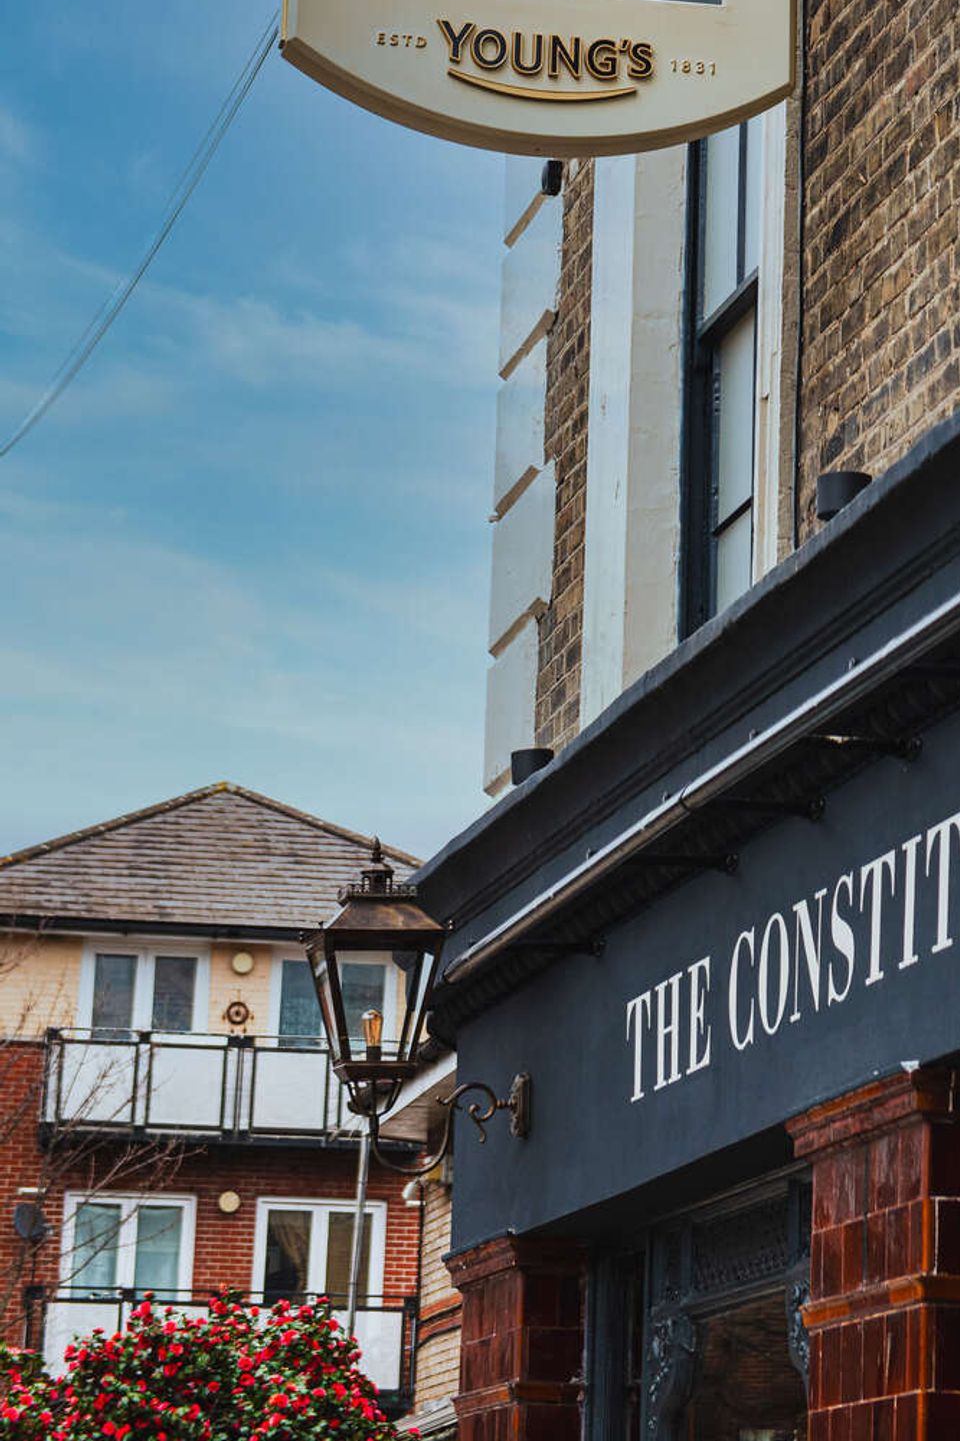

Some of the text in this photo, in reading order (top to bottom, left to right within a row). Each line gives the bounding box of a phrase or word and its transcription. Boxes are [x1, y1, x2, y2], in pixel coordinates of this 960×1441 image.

[375, 18, 717, 80] ESTD YOUNG'S 1831
[625, 956, 712, 1103] THE
